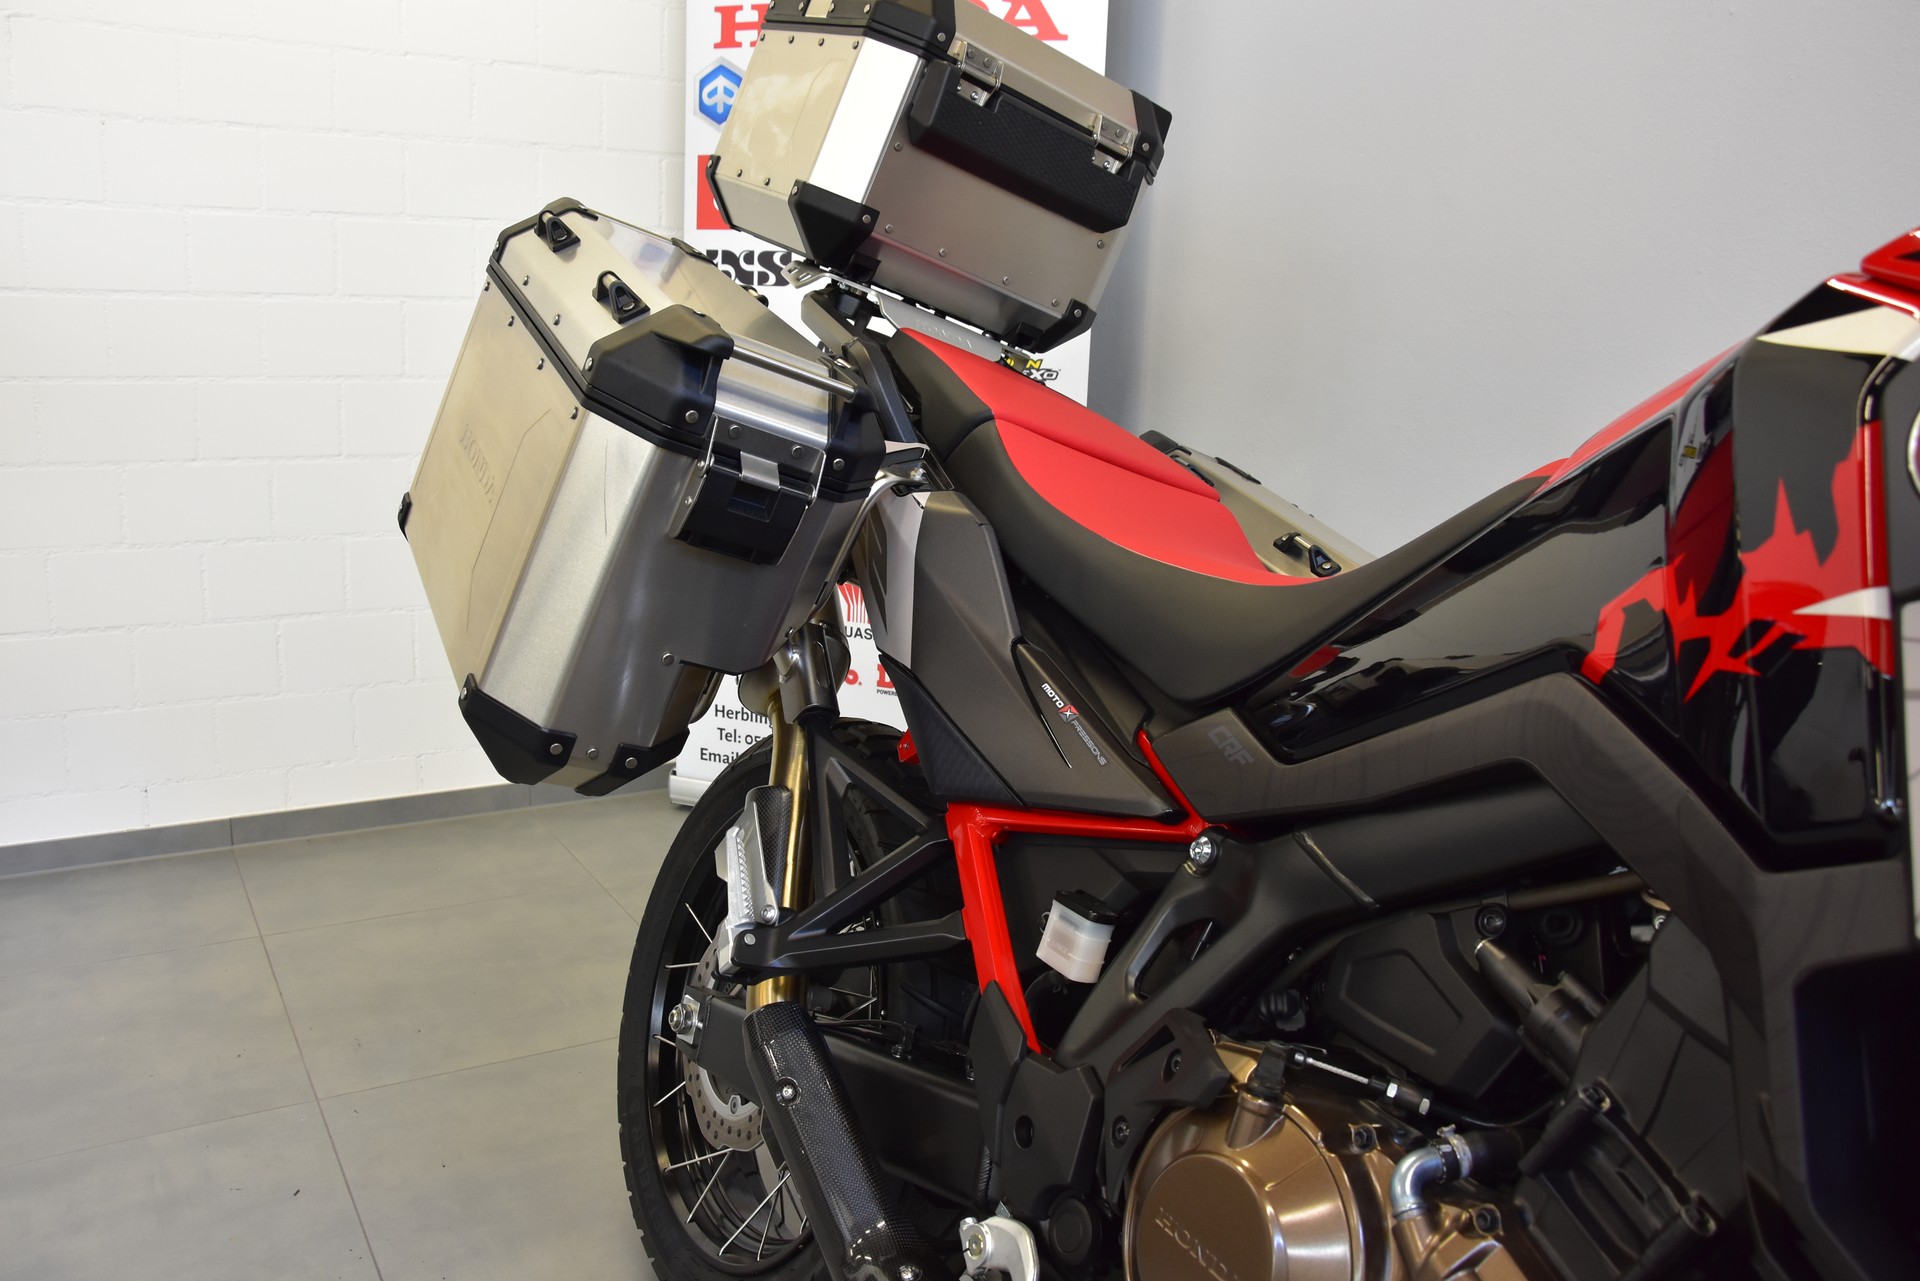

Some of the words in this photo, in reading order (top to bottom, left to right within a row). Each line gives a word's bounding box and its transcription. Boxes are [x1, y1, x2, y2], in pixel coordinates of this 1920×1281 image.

[1041, 683, 1065, 708] MOTO
[717, 727, 742, 744] Tel:
[1207, 725, 1255, 765] CRF
[1155, 1206, 1239, 1281] HOND
